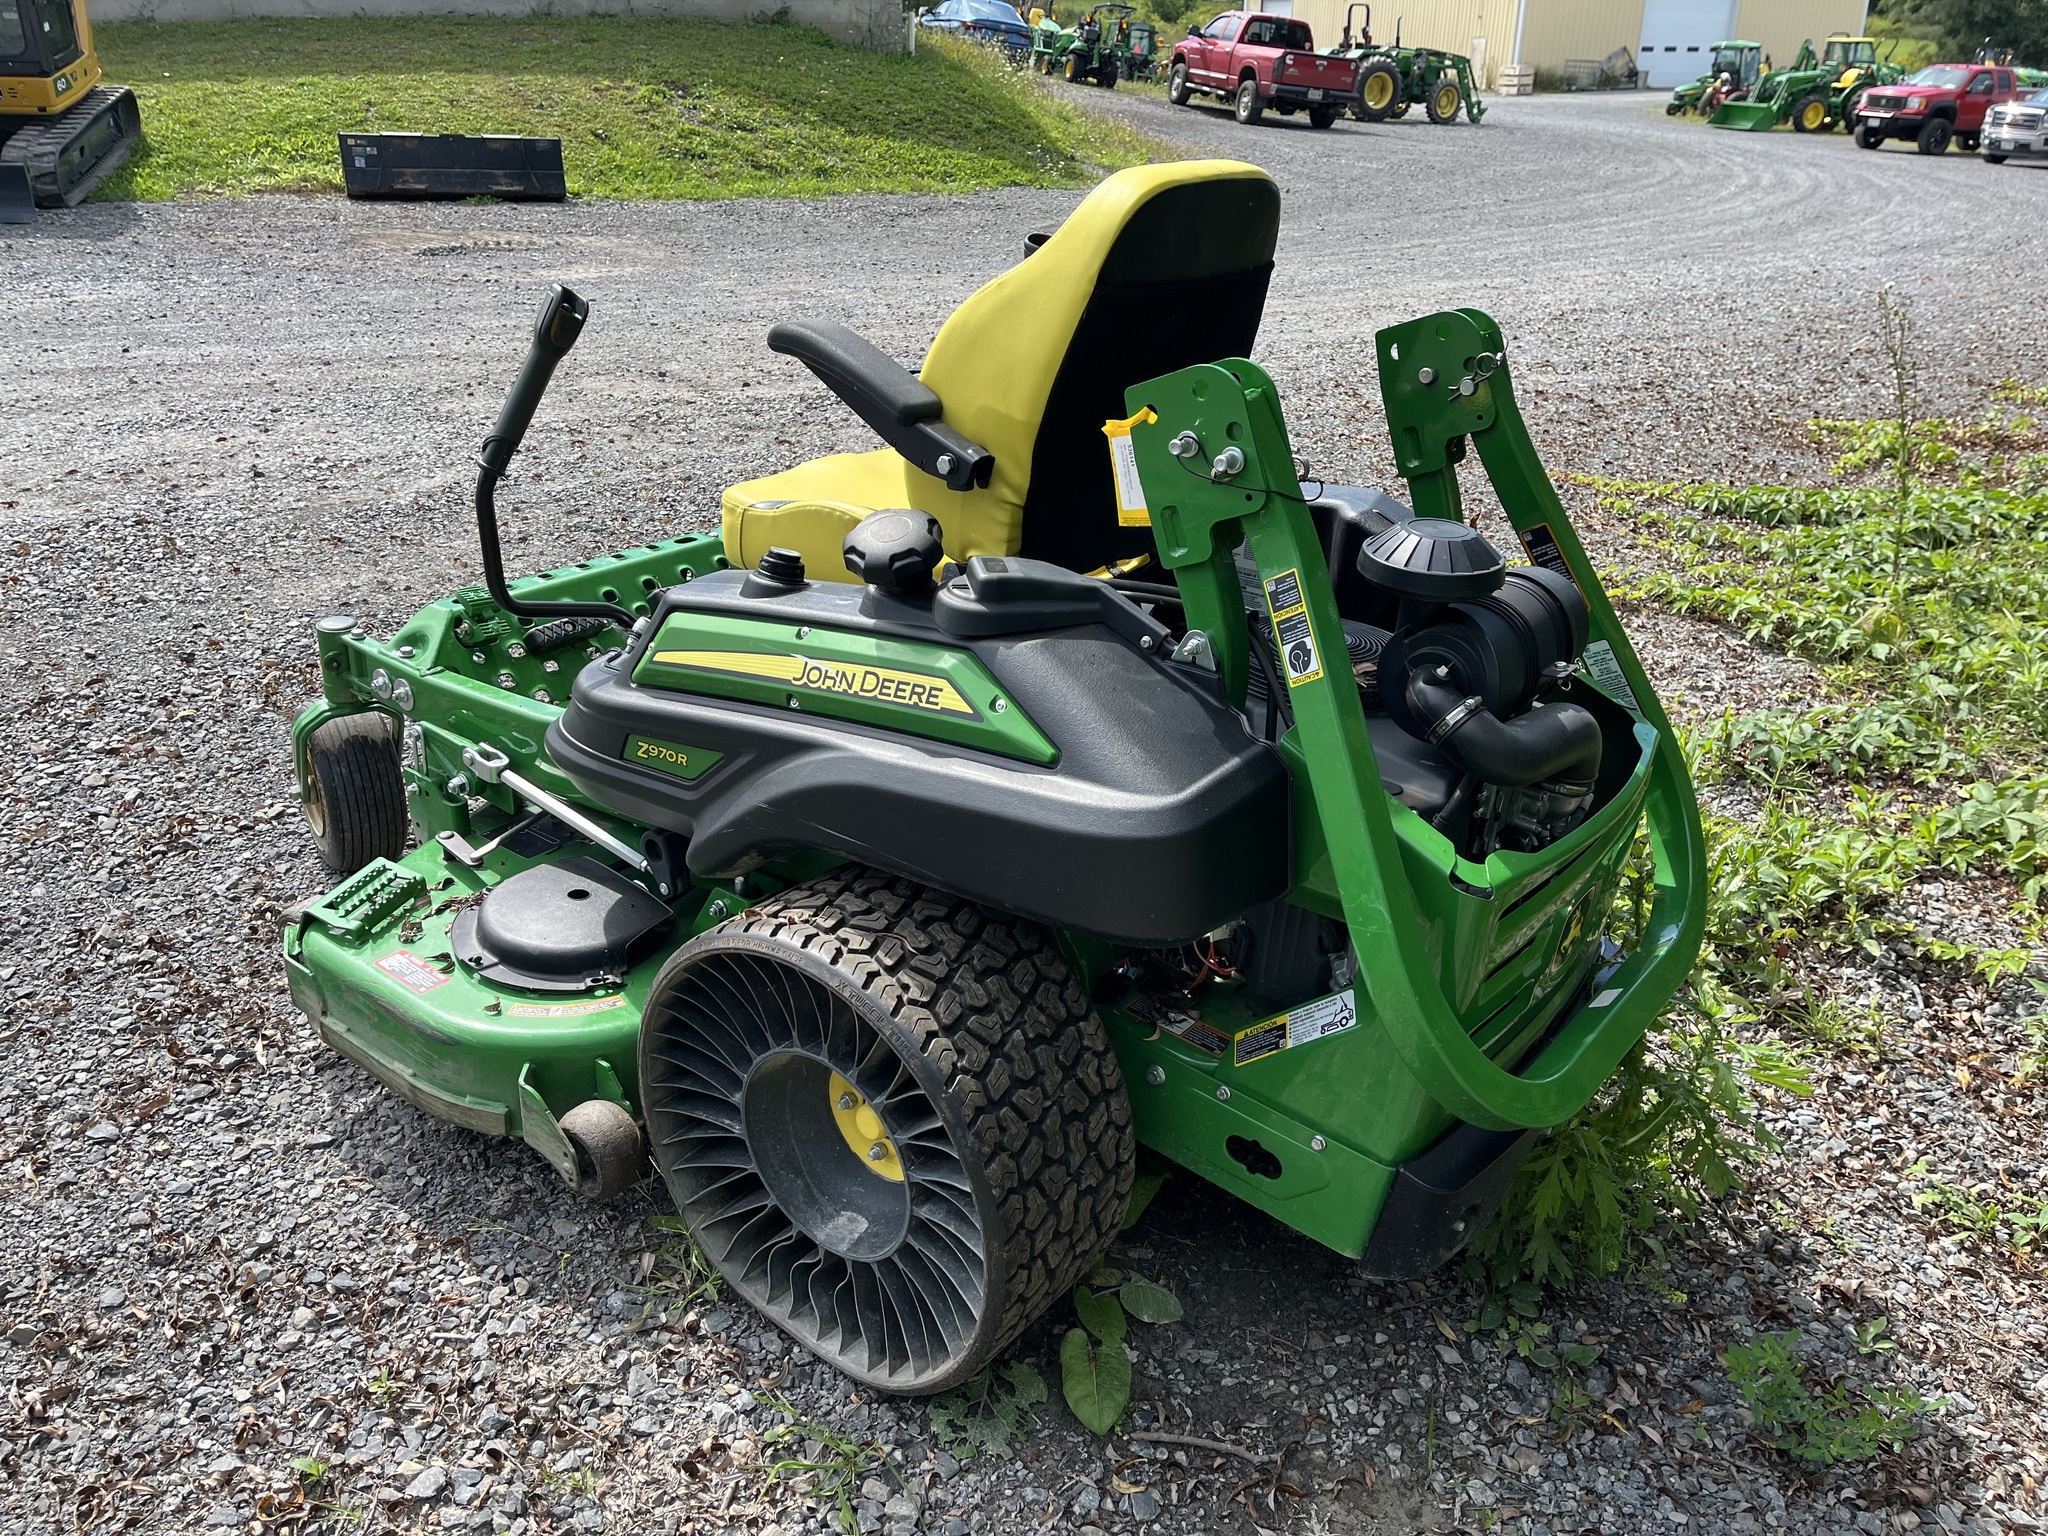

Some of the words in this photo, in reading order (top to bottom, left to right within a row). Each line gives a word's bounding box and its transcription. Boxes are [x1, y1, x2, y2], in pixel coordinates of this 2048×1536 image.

[792, 660, 857, 692] JOHN
[859, 670, 944, 707] DEERE
[1292, 673, 1316, 686] CAUTION
[637, 741, 688, 766] Z970R
[848, 987, 887, 1029] TWEEL
